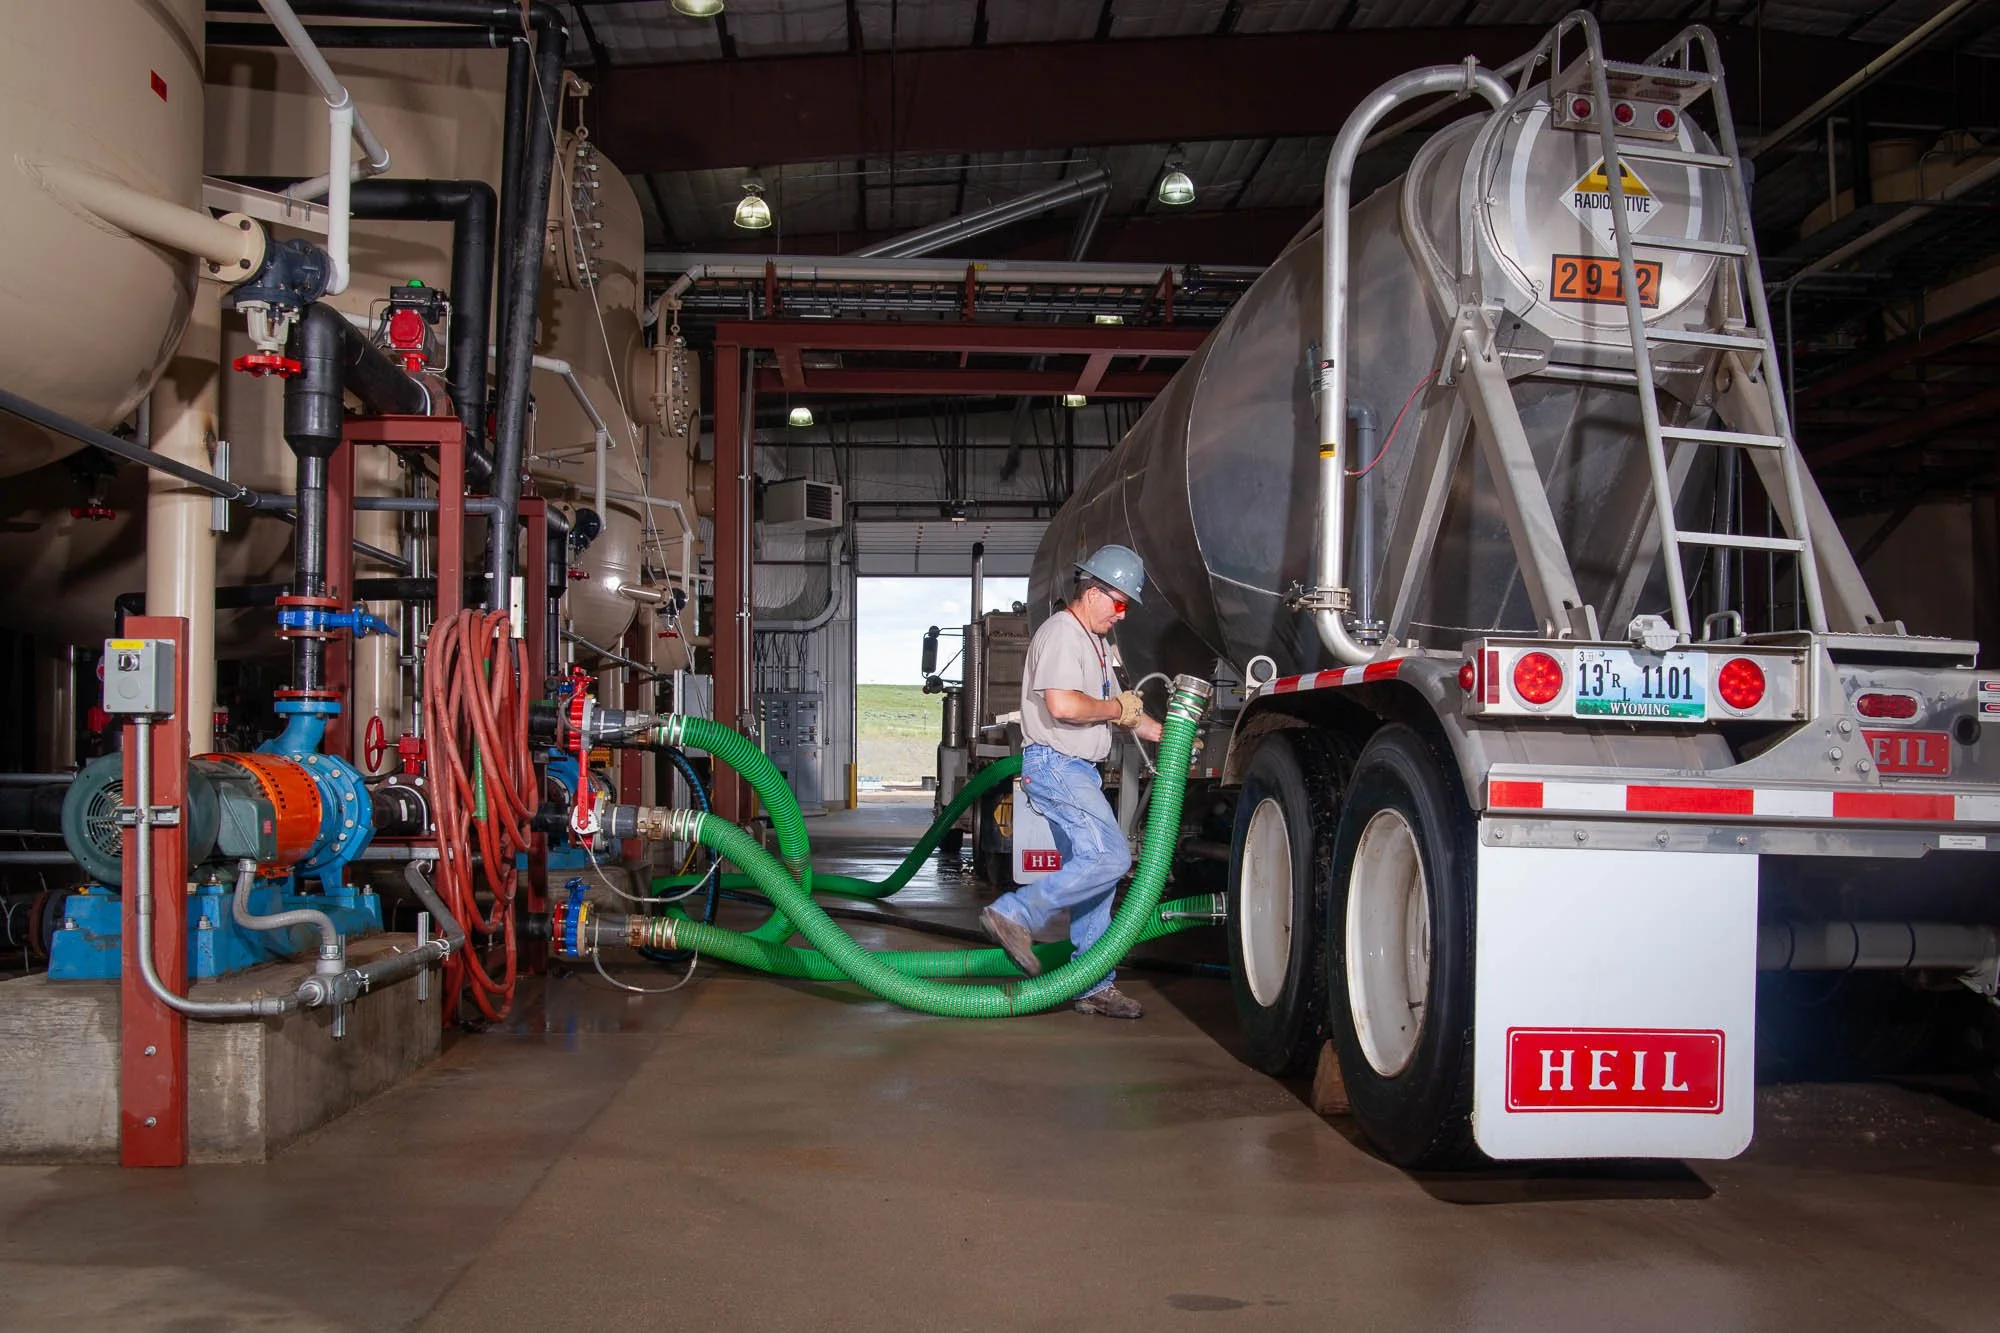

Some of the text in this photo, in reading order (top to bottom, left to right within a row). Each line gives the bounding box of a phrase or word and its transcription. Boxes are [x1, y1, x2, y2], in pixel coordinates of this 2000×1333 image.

[1574, 193, 1650, 213] RADIOTIVE
[1608, 228, 1616, 240] 7
[1560, 262, 1651, 301] 2912
[1579, 663, 1604, 696] 13
[1642, 665, 1692, 699] 1101
[1610, 702, 1670, 715] WYOMING
[1872, 737, 1934, 766] EIL
[1538, 1050, 1689, 1091] HEIL
